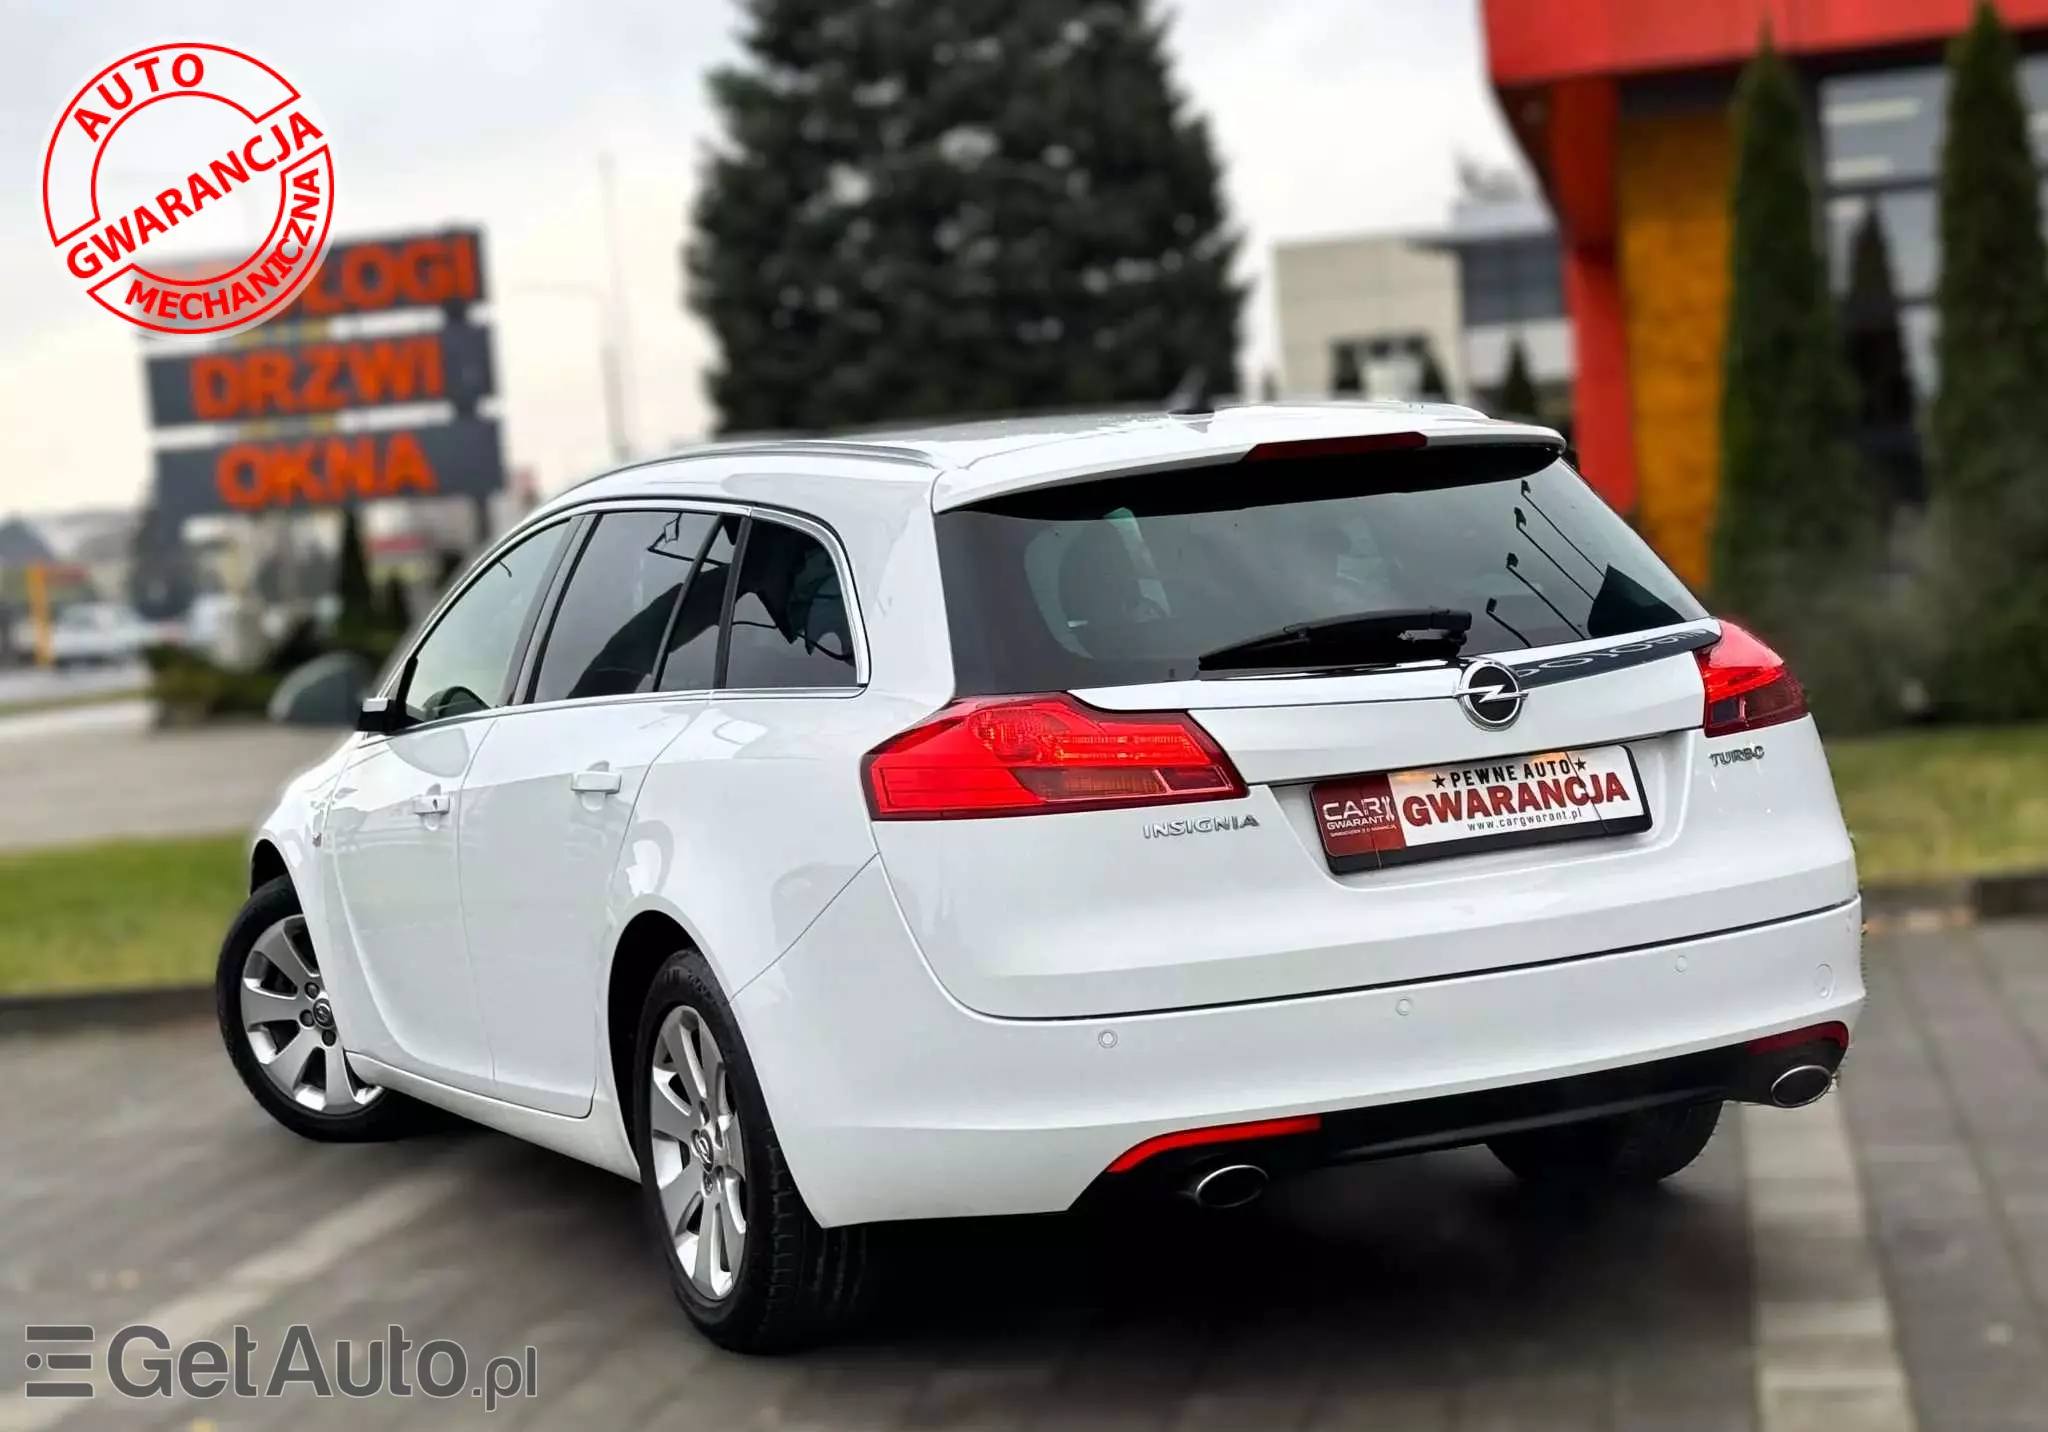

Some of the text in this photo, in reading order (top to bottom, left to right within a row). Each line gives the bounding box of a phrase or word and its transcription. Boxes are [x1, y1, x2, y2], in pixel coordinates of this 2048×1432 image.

[189, 335, 444, 420] DRZWI
[215, 432, 438, 511] OKNA
[1708, 746, 1765, 767] TURBO
[1450, 759, 1571, 788] PEWNE AUTO
[1322, 797, 1382, 820] CAR
[1402, 771, 1630, 827] GWARANCJA
[1143, 814, 1260, 839] INSIGNIA
[1326, 815, 1384, 830] GWARANT
[1467, 808, 1582, 832] www.cargwarant.pl
